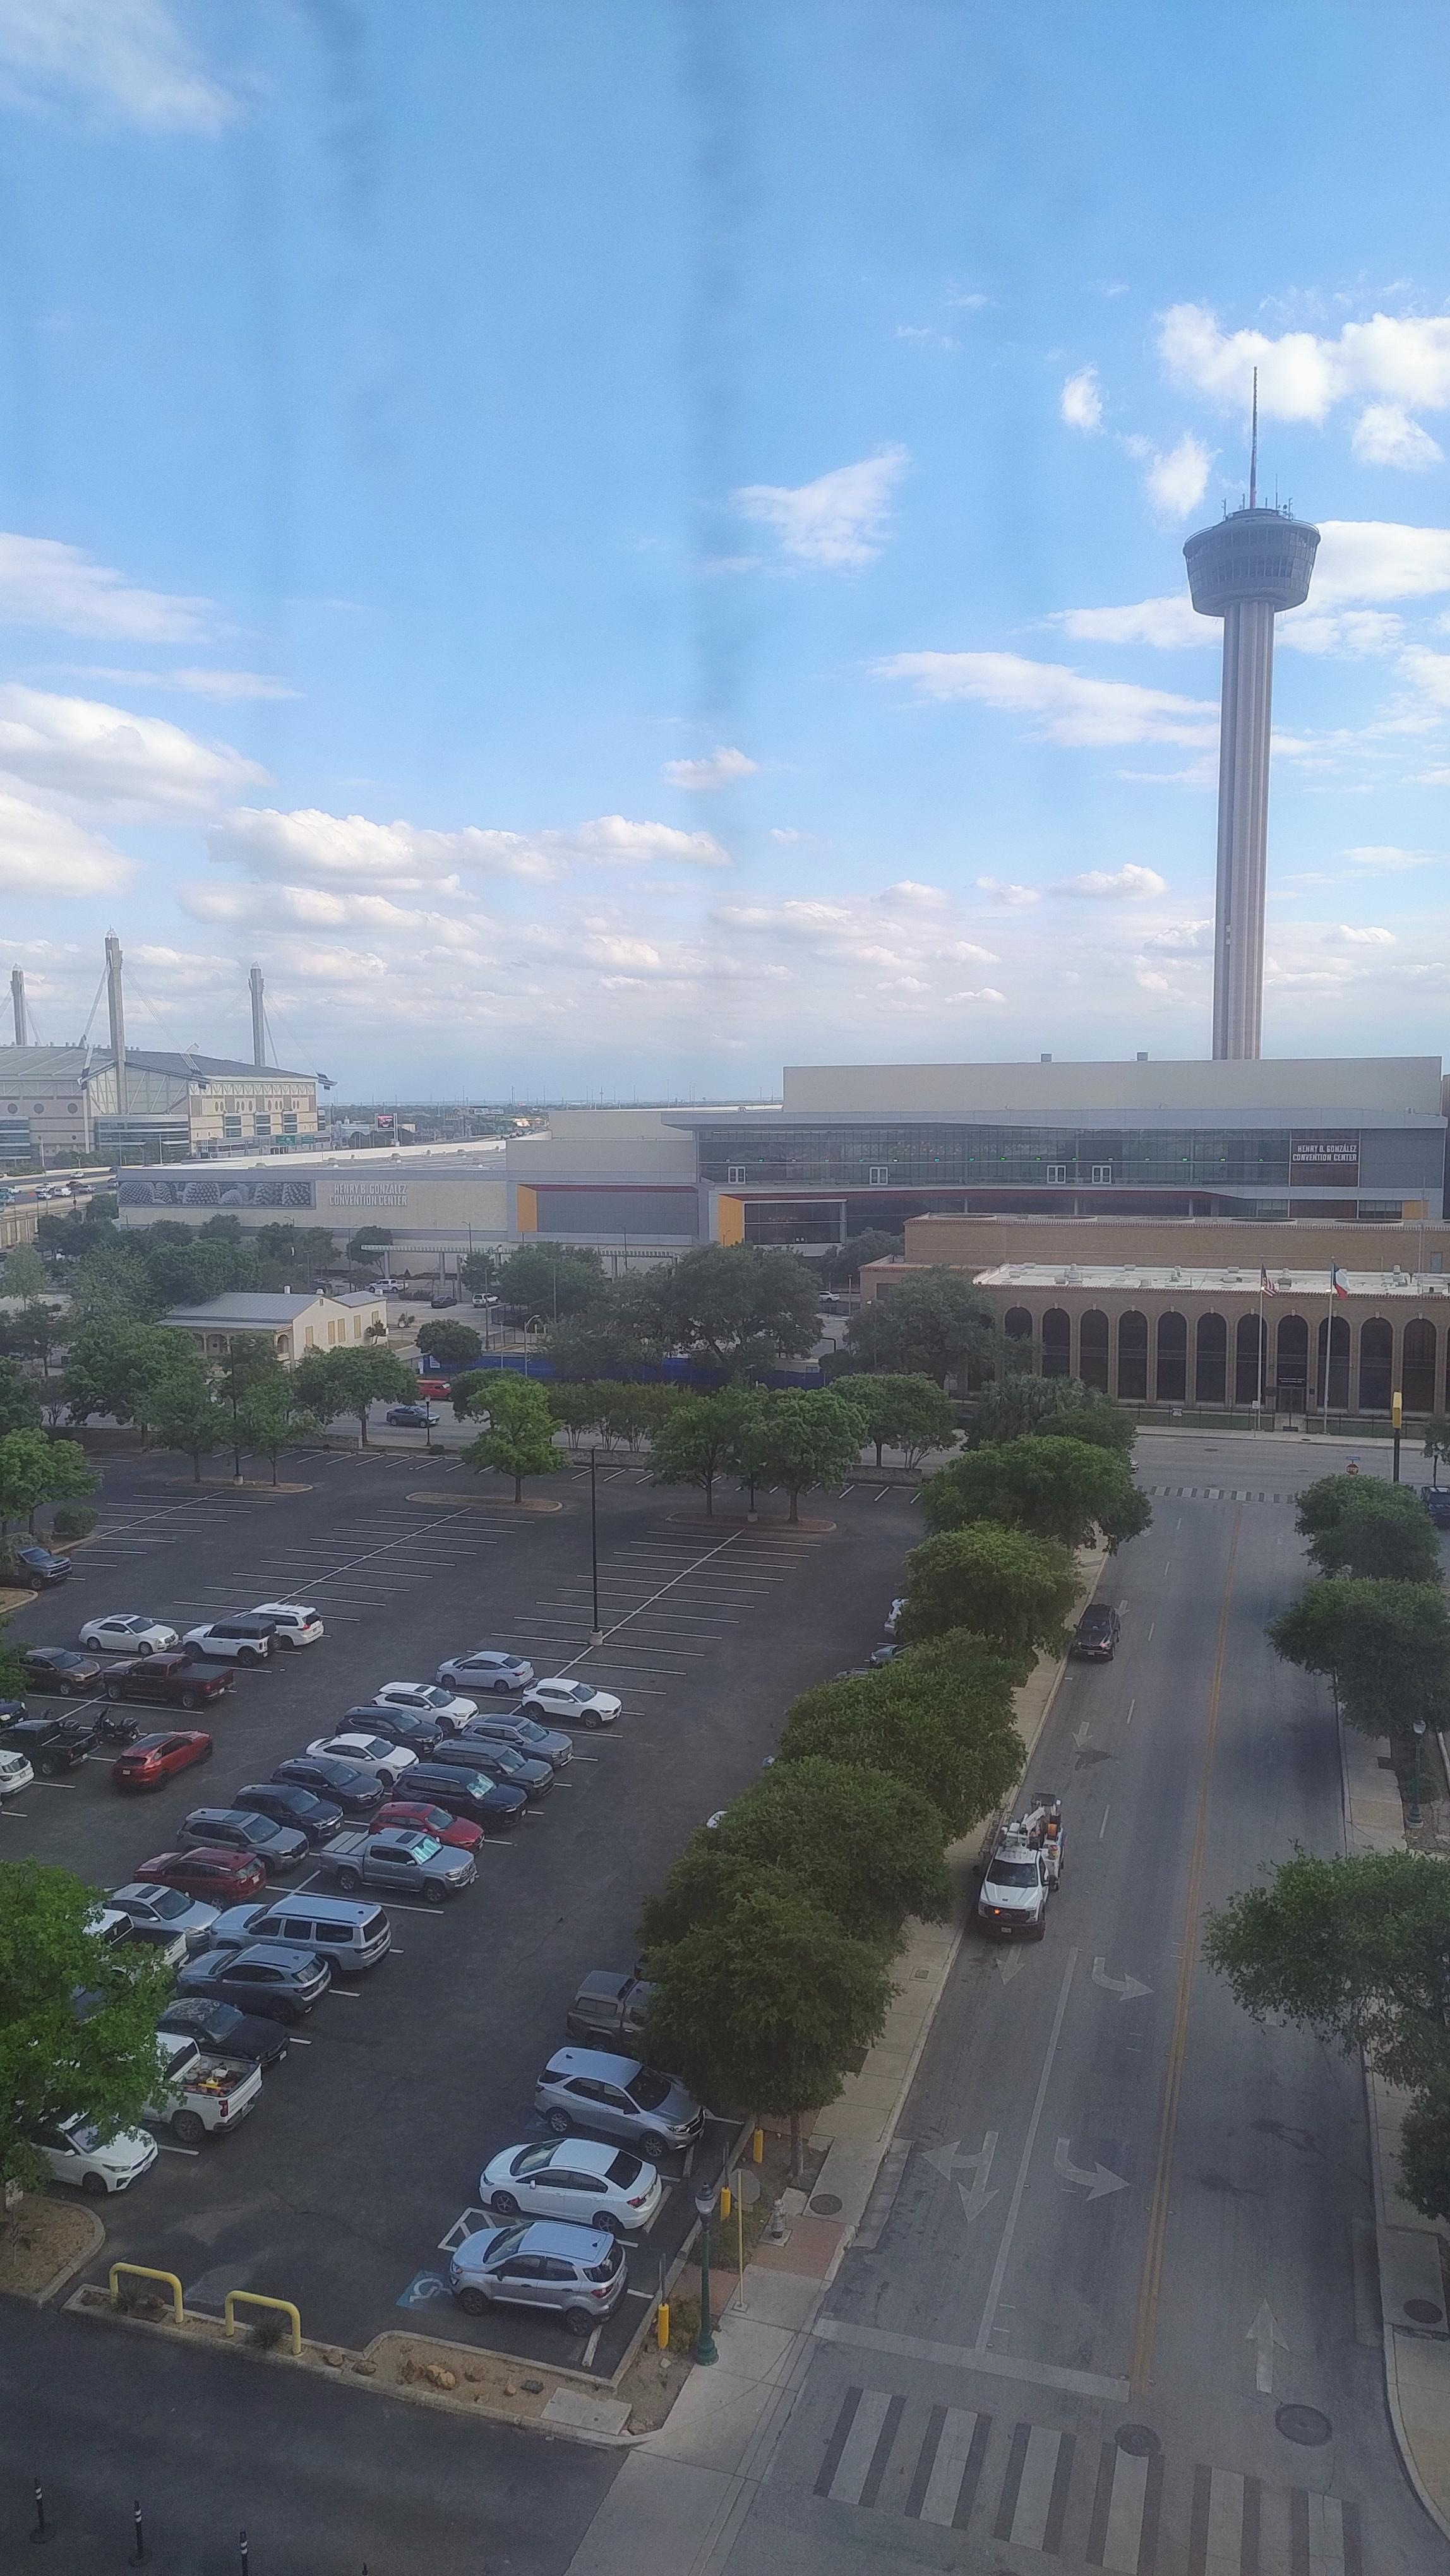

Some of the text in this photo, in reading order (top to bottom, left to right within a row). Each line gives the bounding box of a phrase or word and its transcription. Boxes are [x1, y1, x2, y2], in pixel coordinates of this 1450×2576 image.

[1326, 1143, 1357, 1153] GONZÁLEZ
[335, 1184, 358, 1194] HENRY
[330, 1195, 407, 1206] CONVENTION CENTER
